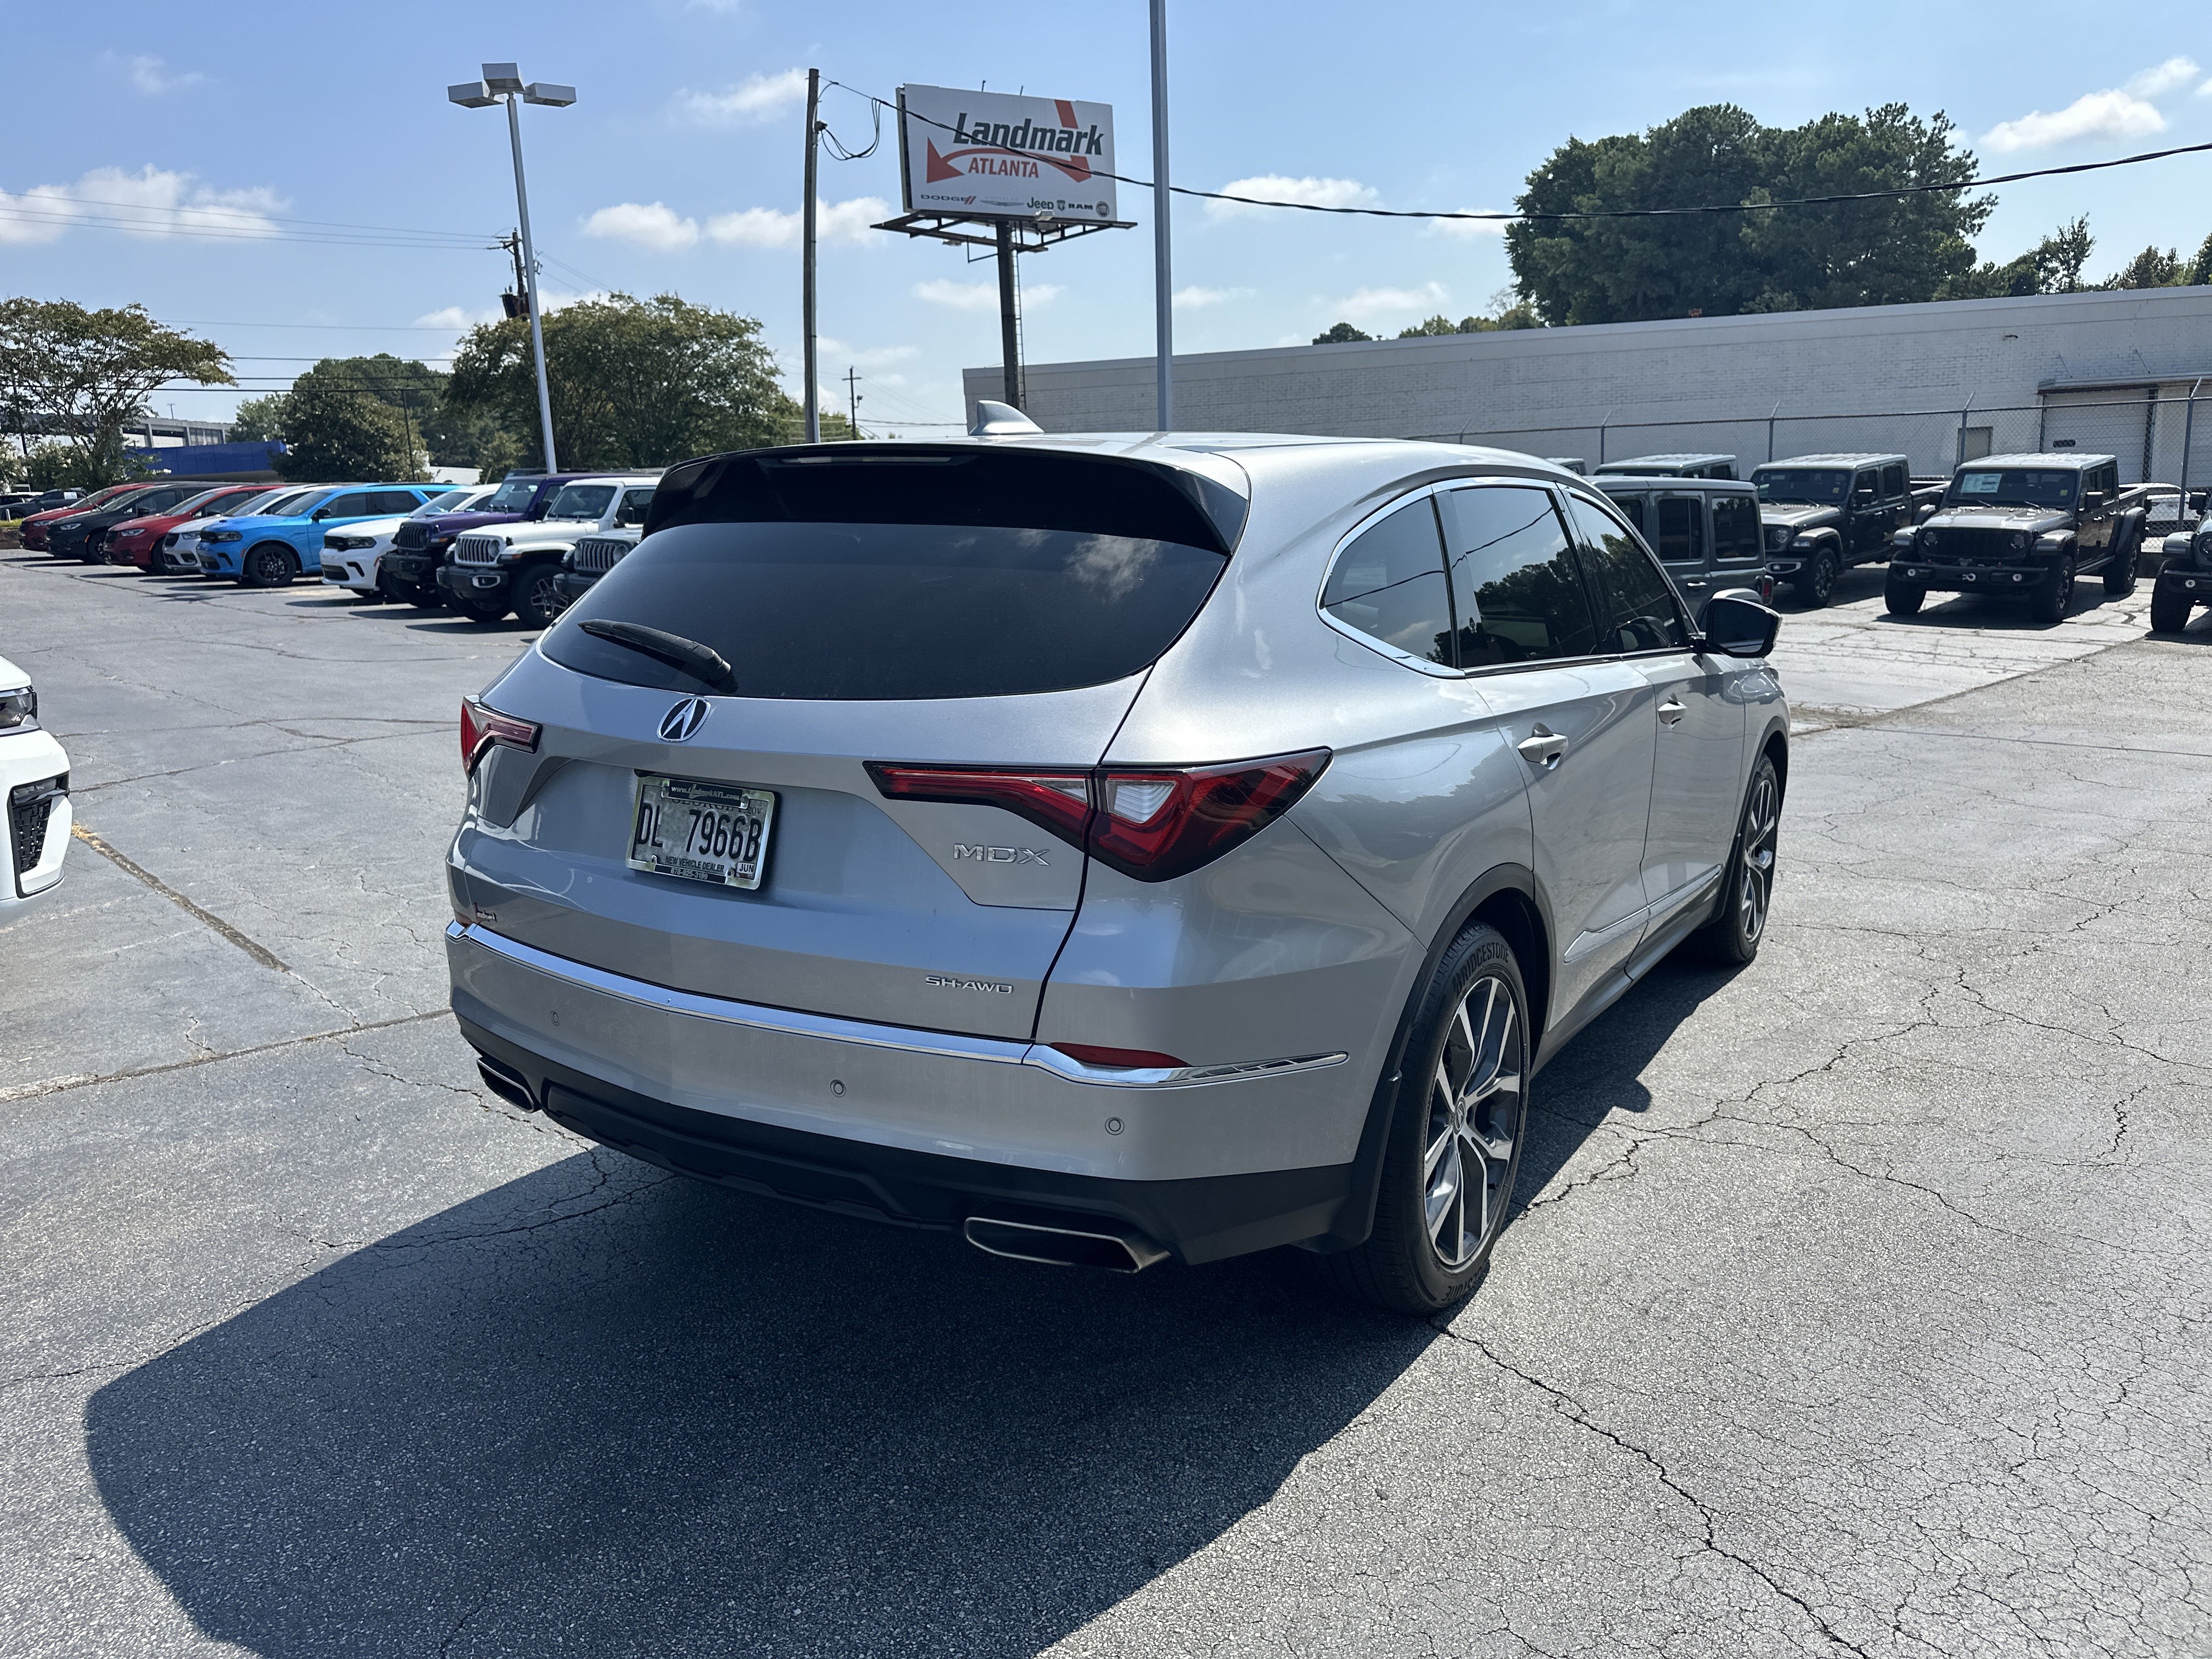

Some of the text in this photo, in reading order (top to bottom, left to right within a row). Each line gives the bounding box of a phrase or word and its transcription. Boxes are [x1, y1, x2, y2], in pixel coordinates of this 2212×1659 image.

[953, 112, 1105, 155] Landmark
[968, 157, 1039, 178] ATLANTA
[1027, 198, 1054, 210] Jeep
[638, 803, 762, 862] DL 7966B
[665, 856, 725, 873] NEW VEHICLE DEALER
[953, 843, 1050, 866] MDX
[740, 864, 754, 873] JUN
[1452, 941, 1509, 1000] BRIDGESTONE
[925, 975, 1014, 995] SH-AWD
